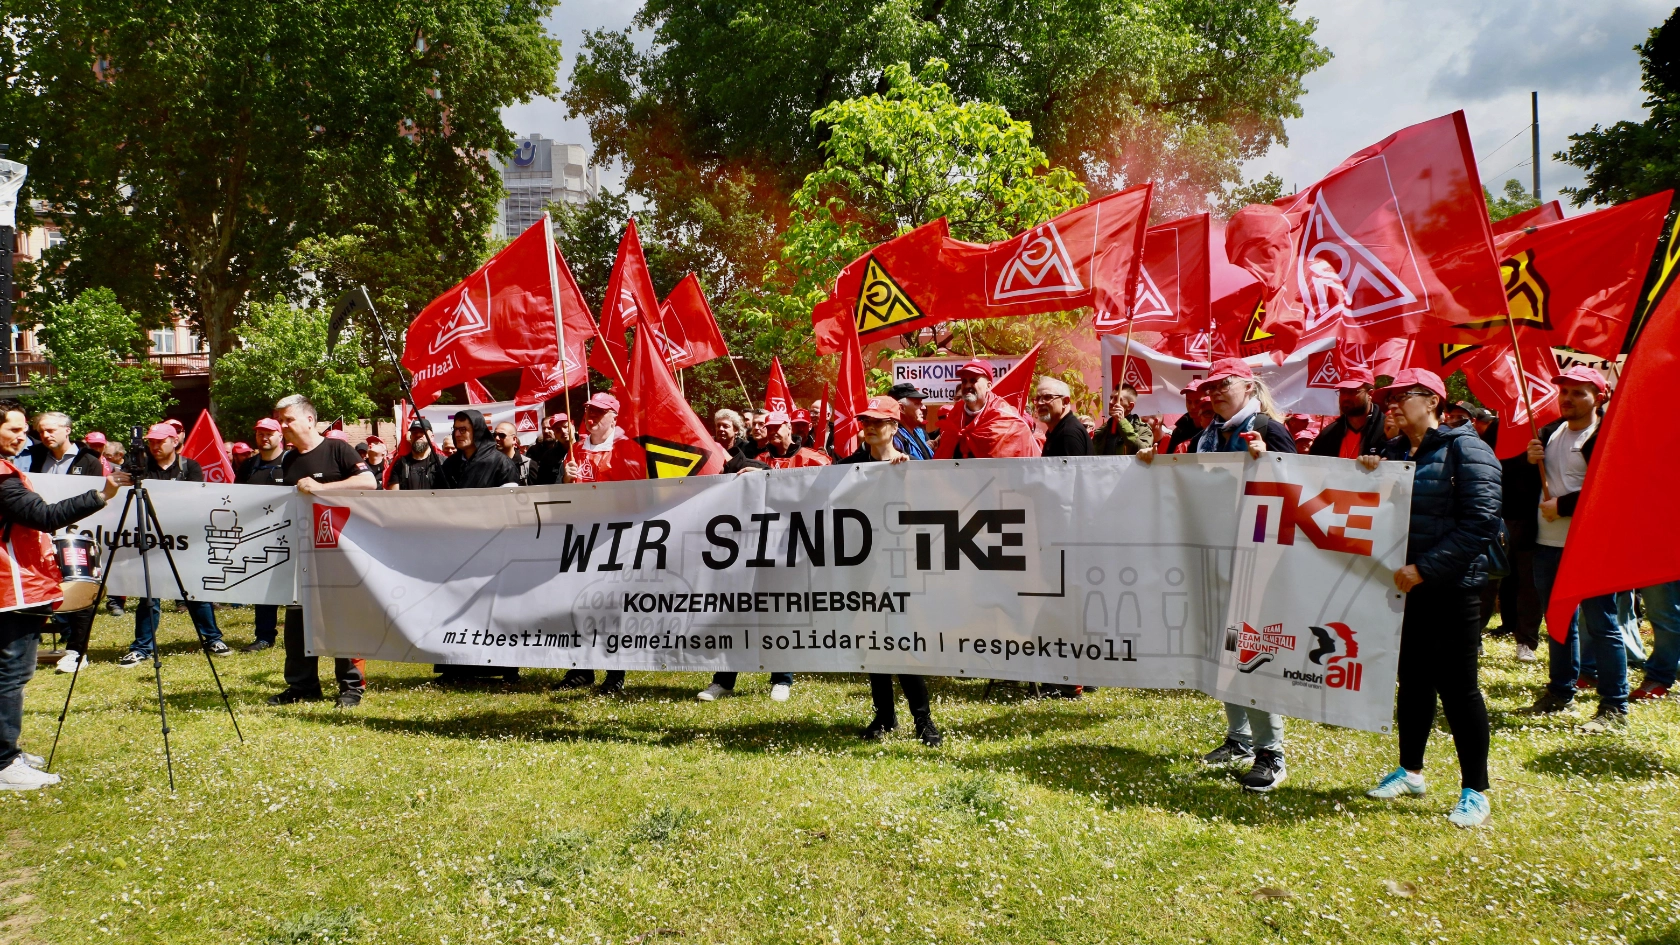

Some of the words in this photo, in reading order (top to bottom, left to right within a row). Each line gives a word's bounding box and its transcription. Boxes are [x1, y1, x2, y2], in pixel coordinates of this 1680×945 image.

[332, 300, 356, 331] CINVEN
[559, 519, 671, 573] WIR
[701, 508, 873, 571] SIND
[898, 508, 1027, 571] TKE
[623, 591, 911, 613] KONZERNBETRIEBSRAT
[1238, 632, 1261, 642] TEAM
[1263, 624, 1281, 633] TEAM
[443, 628, 582, 648] mitbestimmt
[606, 629, 734, 654] gemeinsam
[761, 630, 927, 652] solidarisch
[958, 636, 1138, 662] respektvoll
[1237, 640, 1279, 655] ZUKUNFT
